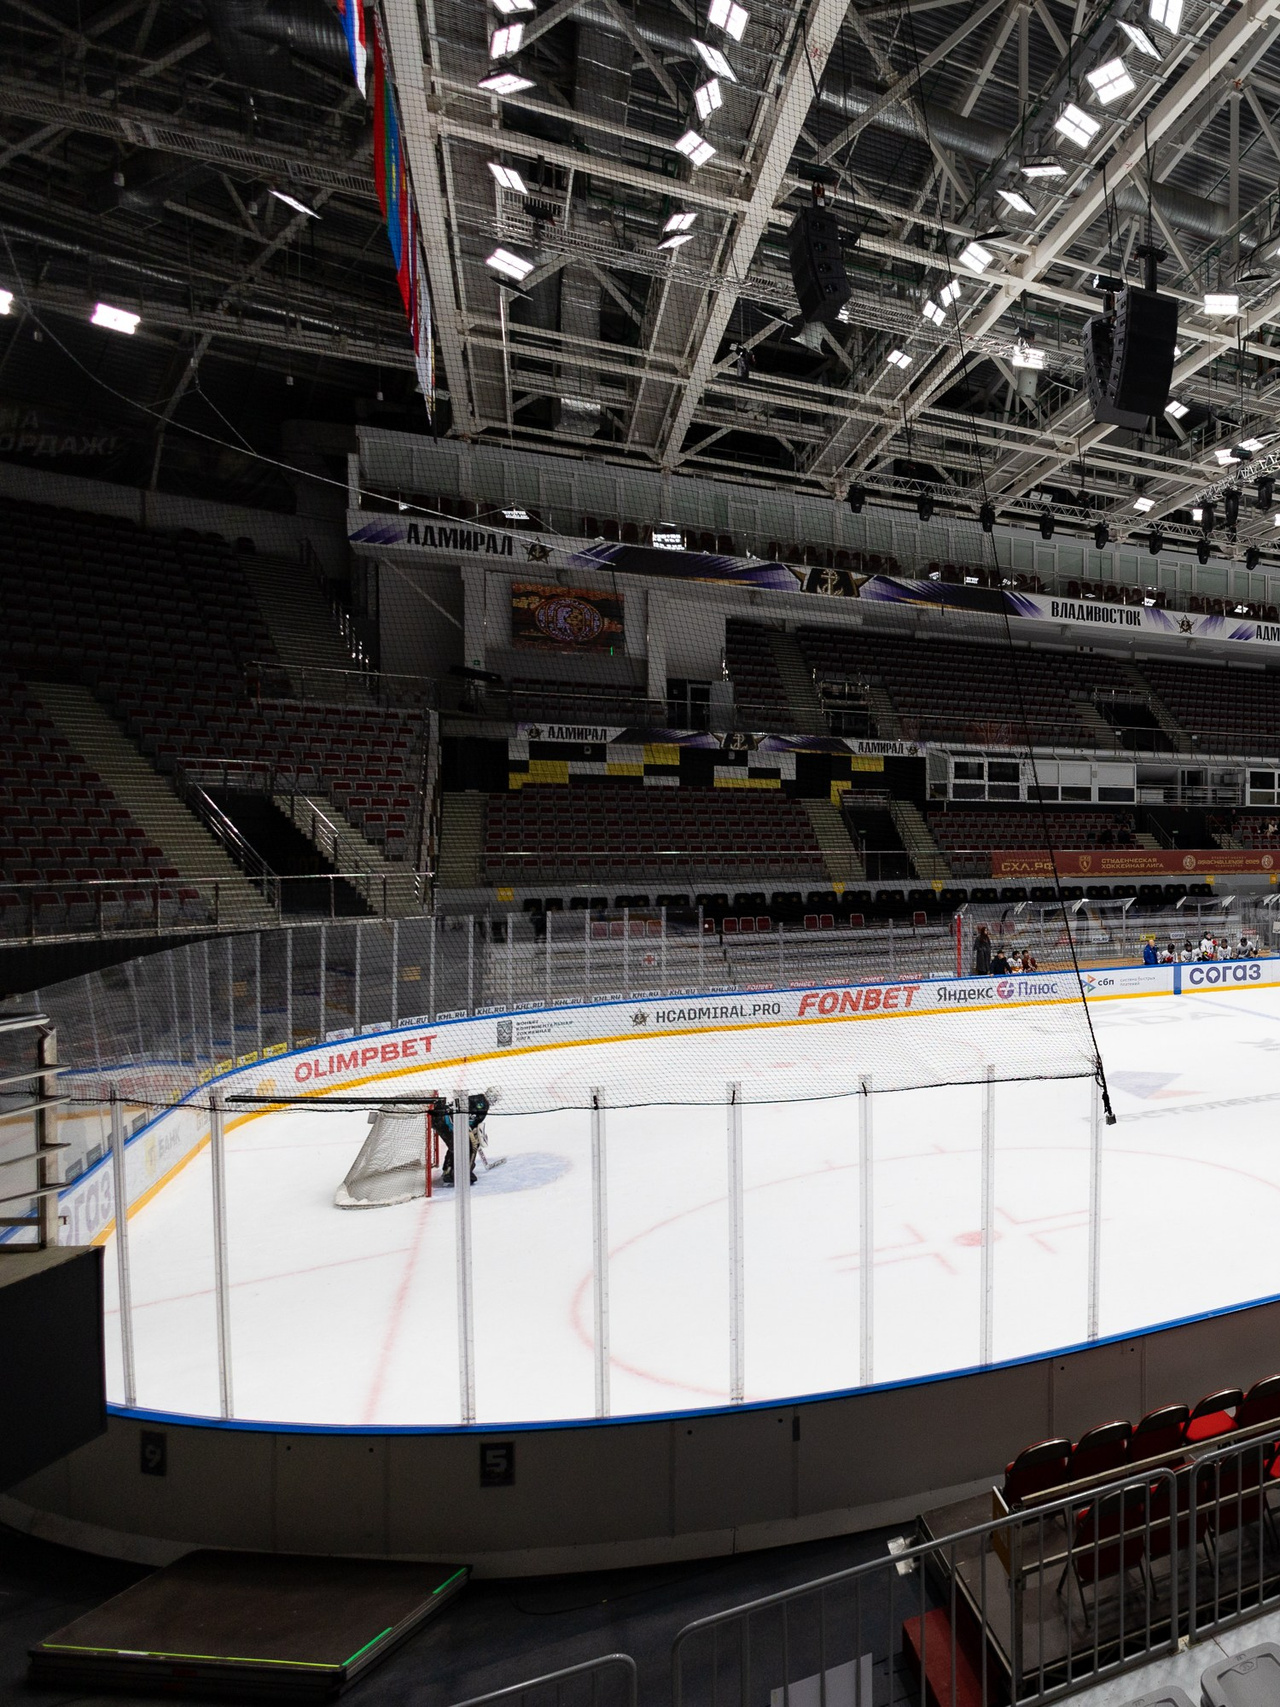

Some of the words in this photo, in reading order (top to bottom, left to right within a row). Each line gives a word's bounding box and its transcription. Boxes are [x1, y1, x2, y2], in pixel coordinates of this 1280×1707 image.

[407, 522, 513, 556] АДМИРАЛ
[1051, 601, 1142, 626] ВЛАДИВОСТОК
[547, 726, 608, 741] АДМИРАЛ
[858, 741, 904, 755] АДМИРАЛ
[1097, 978, 1115, 987] сбп
[1189, 963, 1261, 985] согаз
[797, 985, 920, 1017] FONBET
[936, 986, 993, 1003] Яндекс
[1018, 980, 1058, 996] Плюс
[399, 1016, 428, 1027] KHL.RU
[438, 1009, 466, 1021] KHL.RU
[656, 1003, 781, 1023] HCADMIRAL.PRO
[294, 1034, 437, 1083] OLIMPBET
[145, 1446, 161, 1468] 9
[486, 1449, 507, 1473] 5
